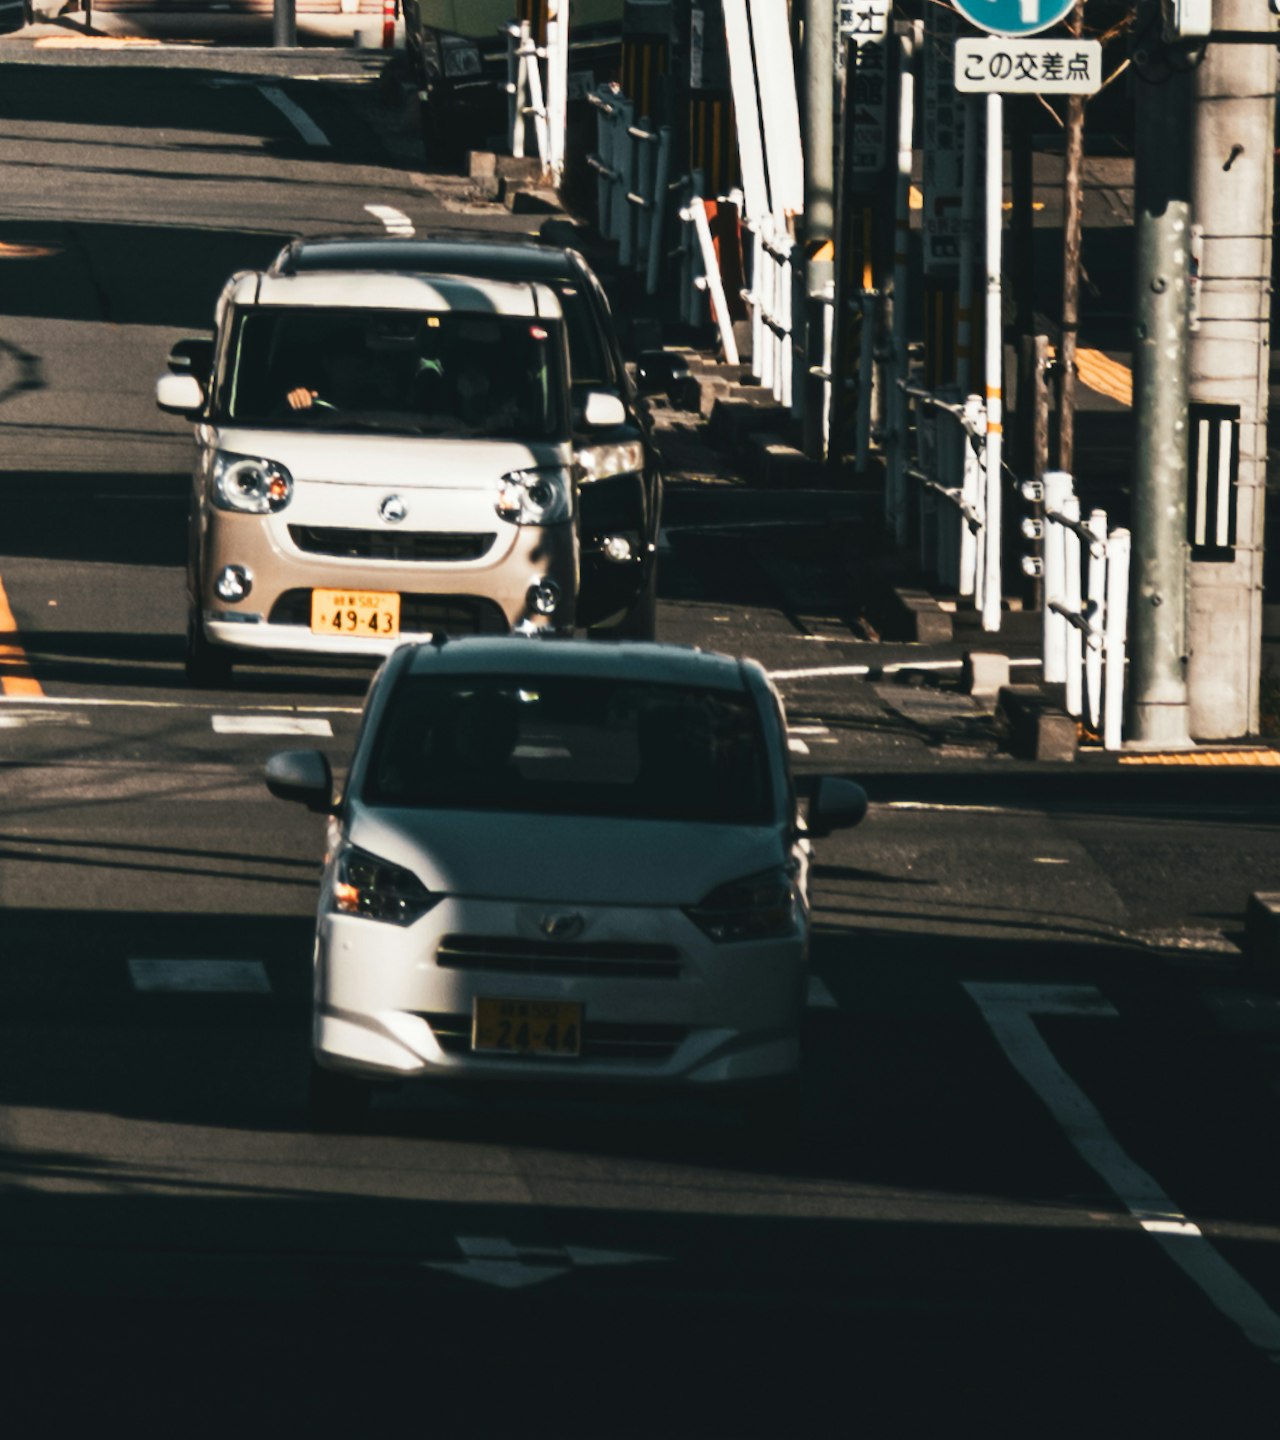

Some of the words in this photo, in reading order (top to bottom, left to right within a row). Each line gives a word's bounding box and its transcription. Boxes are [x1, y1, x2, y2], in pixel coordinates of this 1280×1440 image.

[964, 53, 1090, 81] この交差点
[332, 609, 393, 633] 49-43
